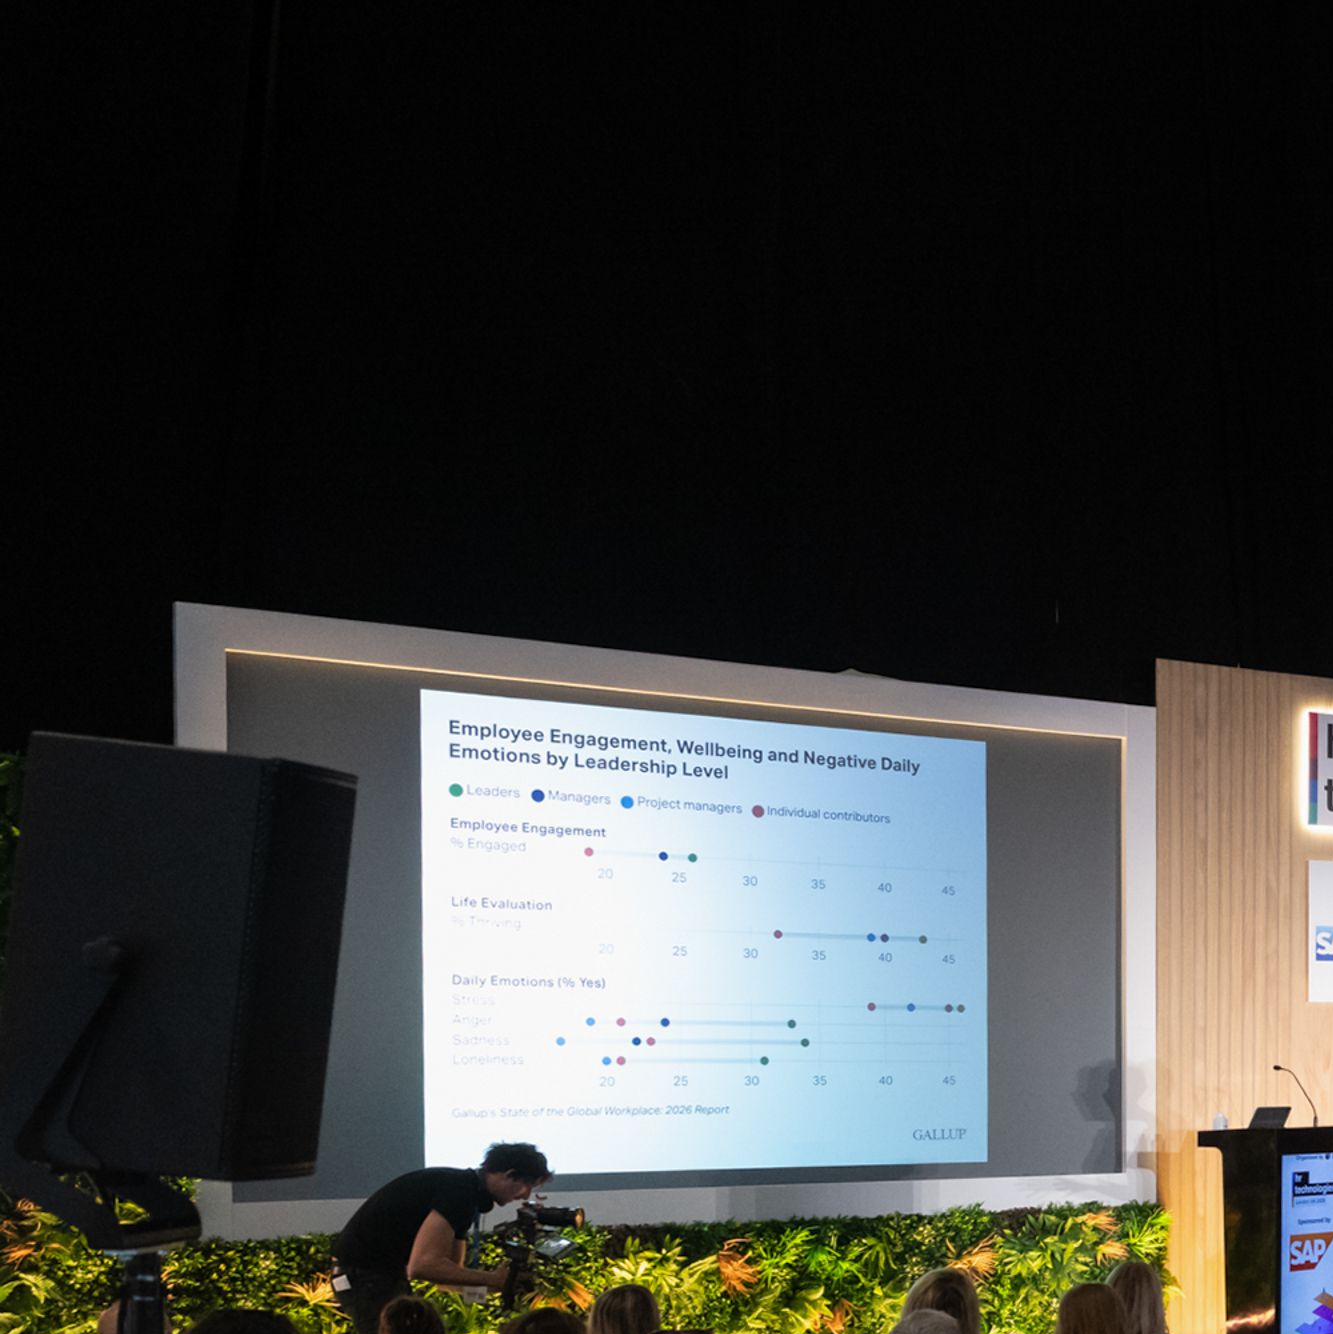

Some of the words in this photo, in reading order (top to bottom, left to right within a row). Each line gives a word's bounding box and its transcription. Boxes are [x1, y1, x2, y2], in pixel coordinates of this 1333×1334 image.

[449, 720, 544, 743] Employee
[550, 729, 672, 754] Engagement,
[677, 740, 763, 763] Wellbeing
[768, 750, 799, 763] and
[803, 751, 877, 770] Negative
[881, 757, 920, 776] Daily
[449, 744, 541, 765] Emotions
[547, 752, 568, 769] by
[575, 754, 677, 777] Leadership
[683, 762, 728, 779] Level
[467, 784, 520, 798] Leaders
[549, 790, 611, 805] Managers
[638, 796, 680, 810] Project
[684, 801, 743, 815] managers
[767, 805, 820, 819] Individual
[824, 810, 891, 824] contributors
[450, 818, 518, 832] Employee
[522, 822, 607, 838] Engagement
[468, 838, 527, 853] Engaged
[598, 868, 613, 880] 20
[672, 872, 687, 883] 25
[743, 876, 758, 887] 30
[811, 879, 826, 891] 35
[878, 883, 892, 894] 40
[942, 885, 956, 896] 45
[451, 897, 477, 909] Life
[481, 898, 553, 912] Evaluation
[672, 946, 687, 957] 25
[743, 948, 758, 959] 30
[811, 950, 826, 961] 35
[878, 952, 892, 963] 40
[942, 954, 956, 965] 45
[452, 974, 486, 989] Daily
[490, 976, 554, 988] Emotions
[557, 976, 575, 990] (%
[579, 977, 606, 990] Yes)
[600, 1076, 615, 1087] 20
[673, 1076, 688, 1087] 25
[744, 1076, 760, 1087] 30
[812, 1076, 827, 1087] 35
[879, 1076, 893, 1087] 40
[942, 1075, 957, 1086] 45
[499, 1107, 529, 1118] State
[532, 1107, 545, 1117] of
[547, 1107, 564, 1117] the
[567, 1106, 602, 1117] Global
[665, 1105, 692, 1115] 2026
[695, 1104, 730, 1117] Report
[912, 1128, 967, 1142] GALLUP
[1290, 1238, 1325, 1265] SAP
